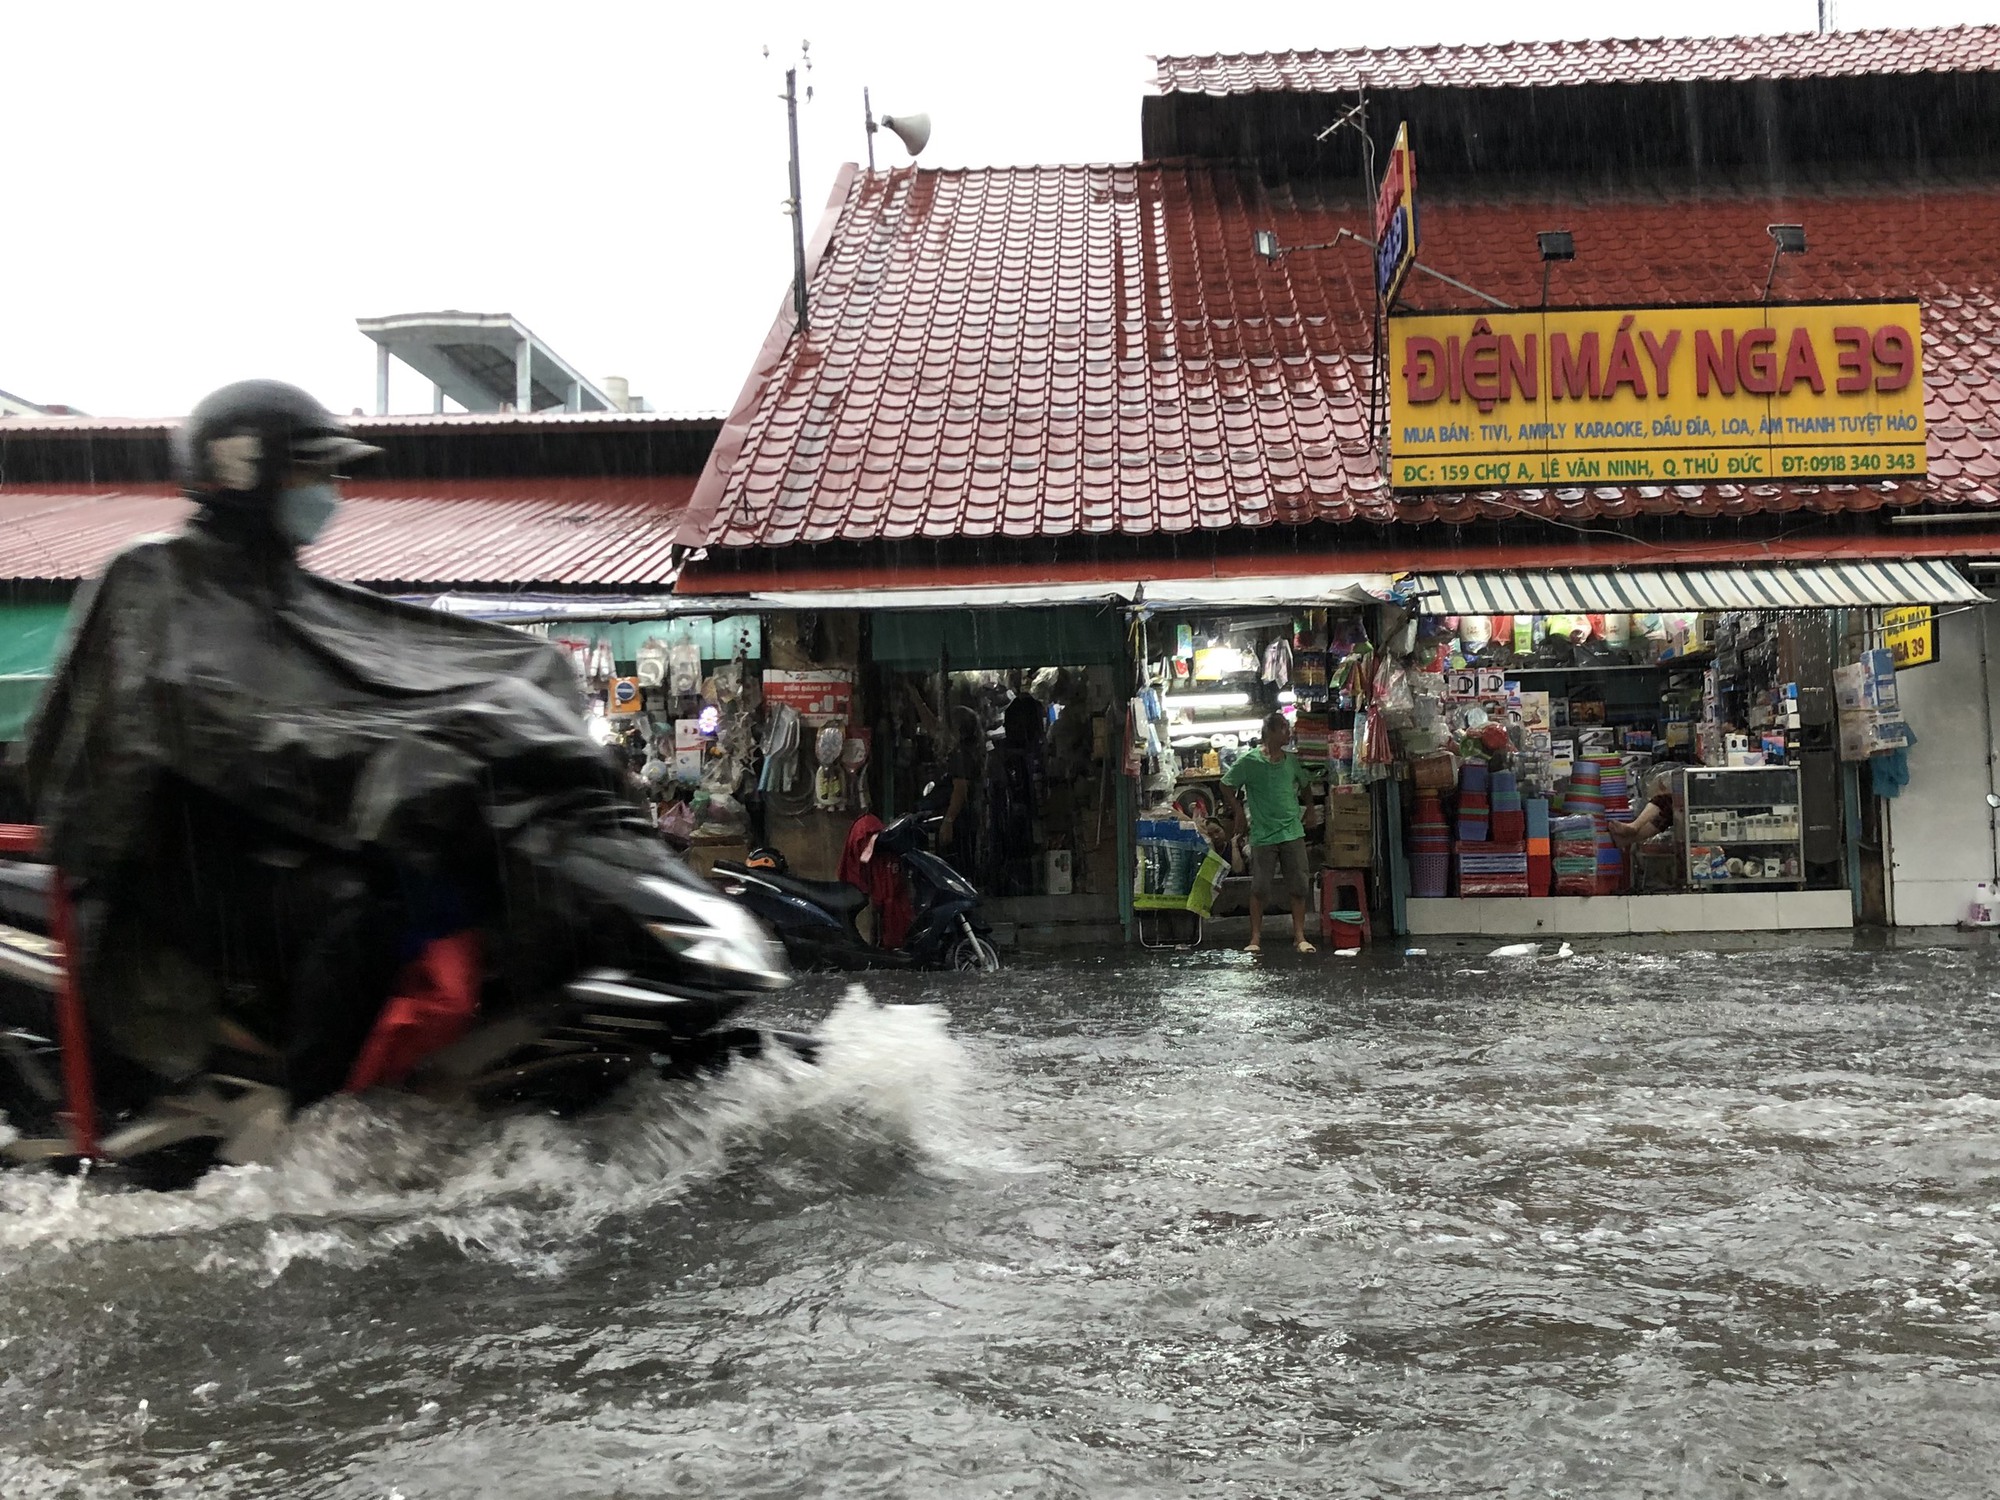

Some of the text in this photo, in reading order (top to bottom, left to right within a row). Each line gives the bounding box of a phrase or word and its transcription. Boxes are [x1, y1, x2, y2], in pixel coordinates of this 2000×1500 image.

[1402, 315, 1914, 413] ĐIỆN MÁY NGA 39
[1404, 427, 1435, 443] MUA
[1479, 424, 1512, 443] TIVI,
[1518, 422, 1567, 440] AMPLY
[1574, 421, 1648, 439] KARAOKE,
[1722, 418, 1755, 436] LOA,
[1759, 414, 1783, 434] ÂM
[1786, 416, 1836, 434] THANH
[1838, 412, 1883, 436] TUYỆT
[1886, 409, 1918, 431] HẢO
[1440, 464, 1470, 481] 159
[1474, 461, 1511, 484] CHỢ
[1517, 462, 1535, 480] A,
[1541, 458, 1560, 478] LÊ
[1566, 457, 1600, 478] VĂN
[1607, 459, 1654, 478] NINH,
[1727, 452, 1763, 474] ĐỨC
[1850, 454, 1880, 471] 340
[1885, 453, 1915, 469] 343
[1911, 637, 1925, 657] 39
